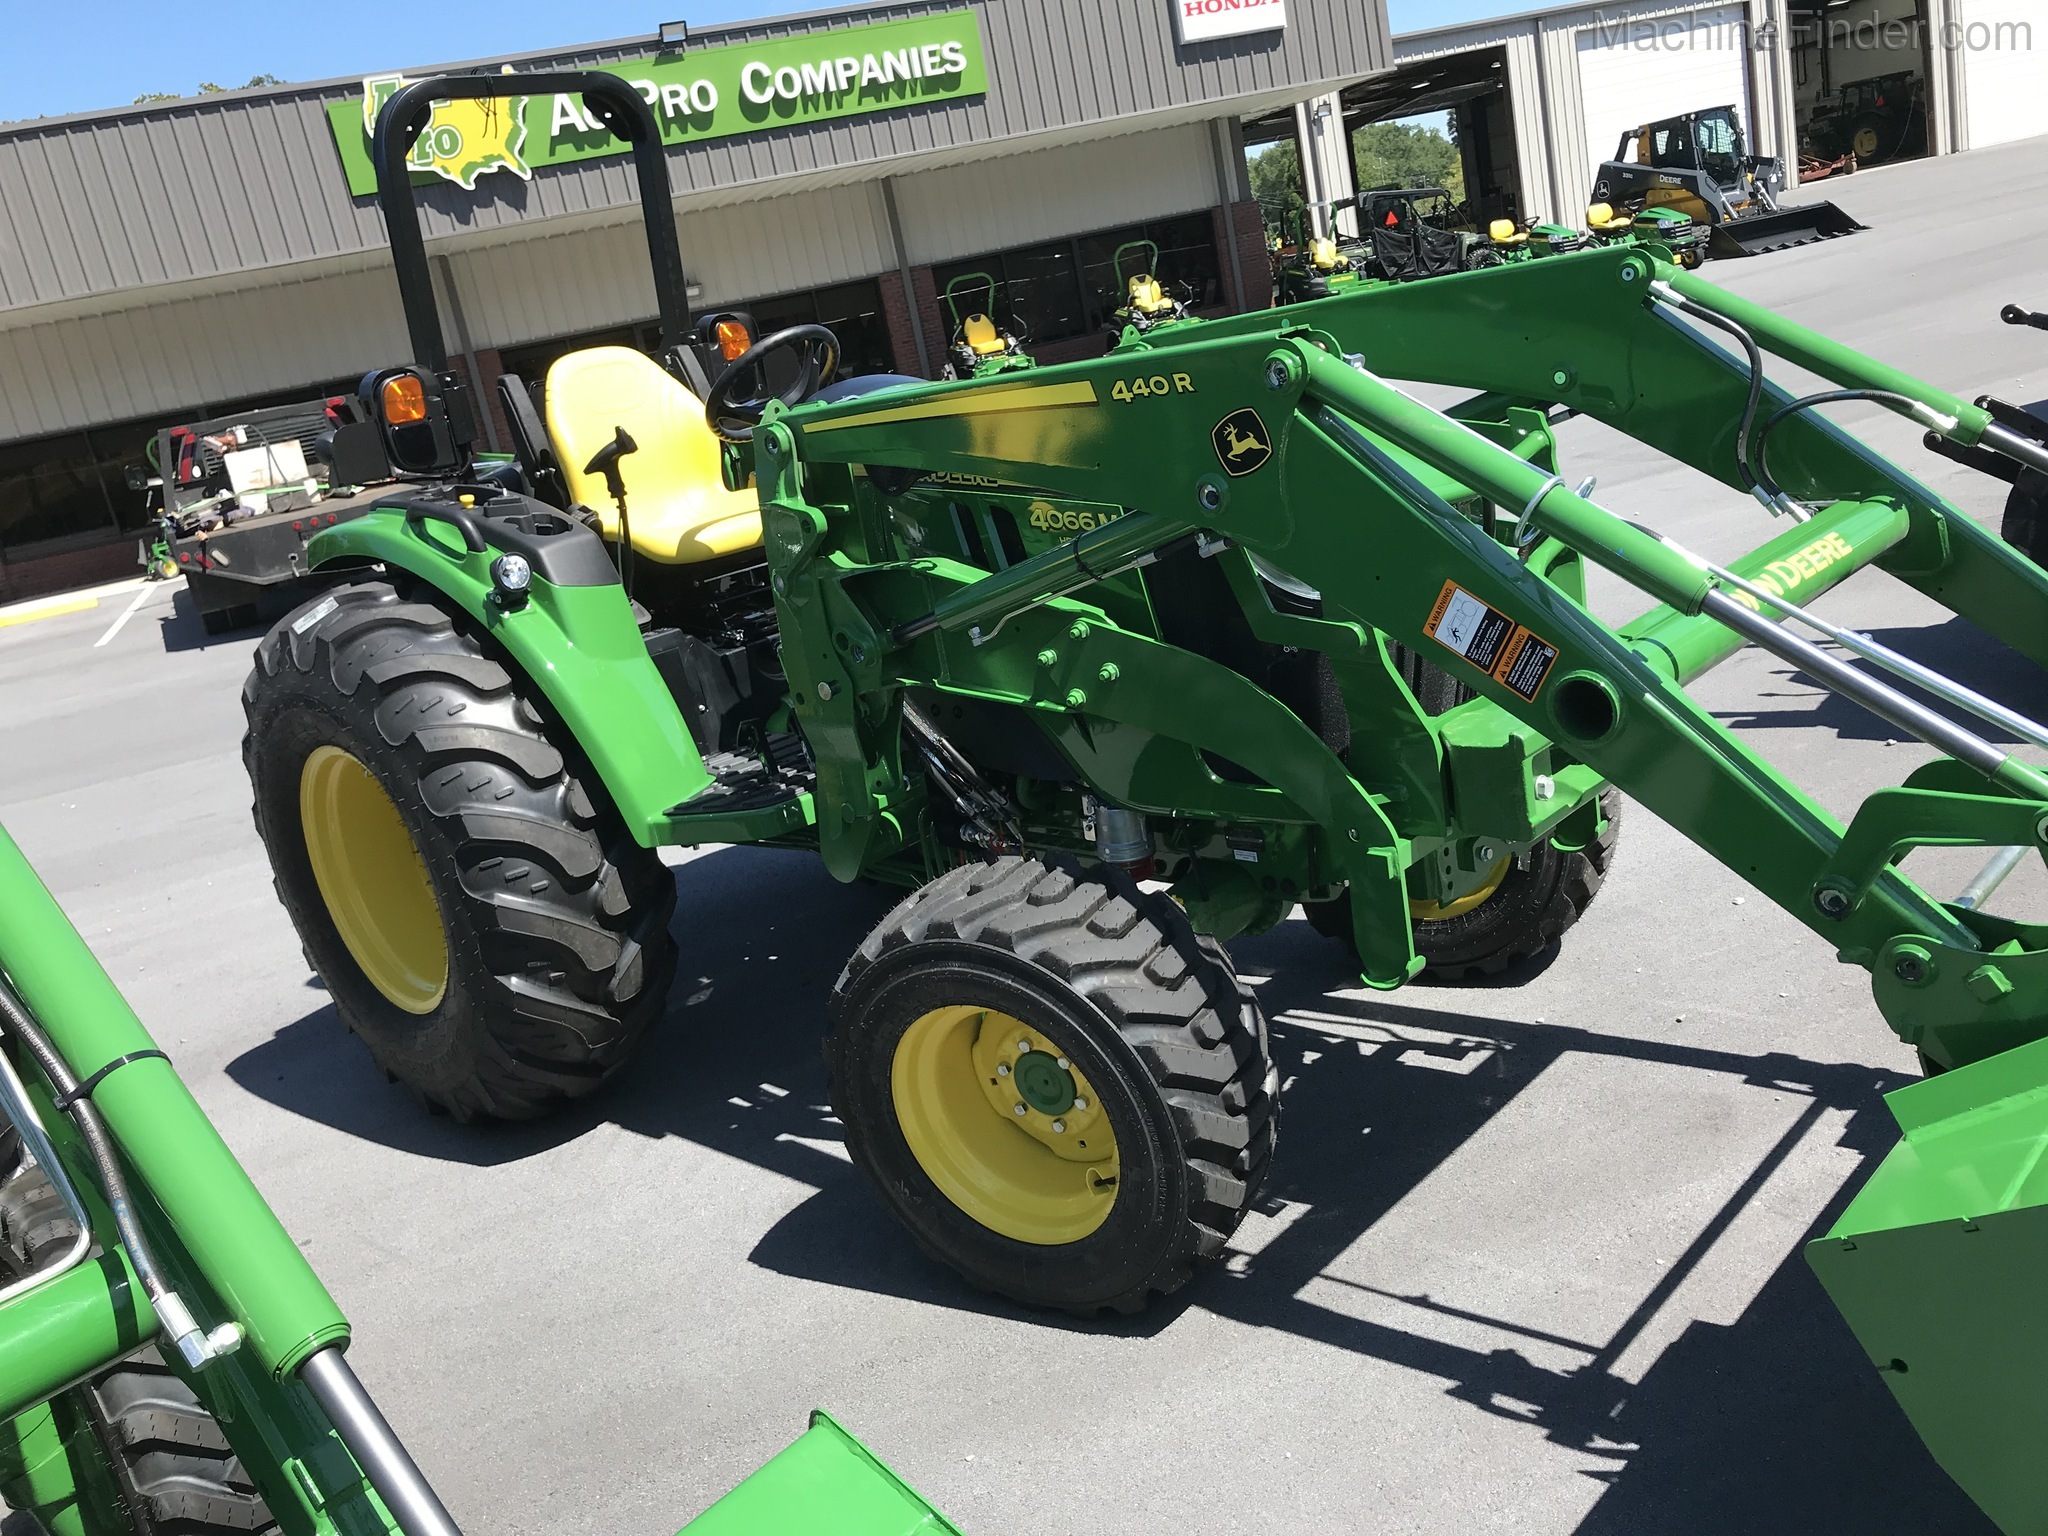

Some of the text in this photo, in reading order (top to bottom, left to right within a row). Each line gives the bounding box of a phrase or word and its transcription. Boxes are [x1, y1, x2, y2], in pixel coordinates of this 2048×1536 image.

[1659, 174, 1682, 185] DEERE
[1111, 372, 1196, 403] 440 R
[1030, 507, 1096, 532] 4066
[1764, 531, 1853, 590] DEERE
[1432, 587, 1452, 622] WARNING
[1503, 633, 1525, 668] WARNING
